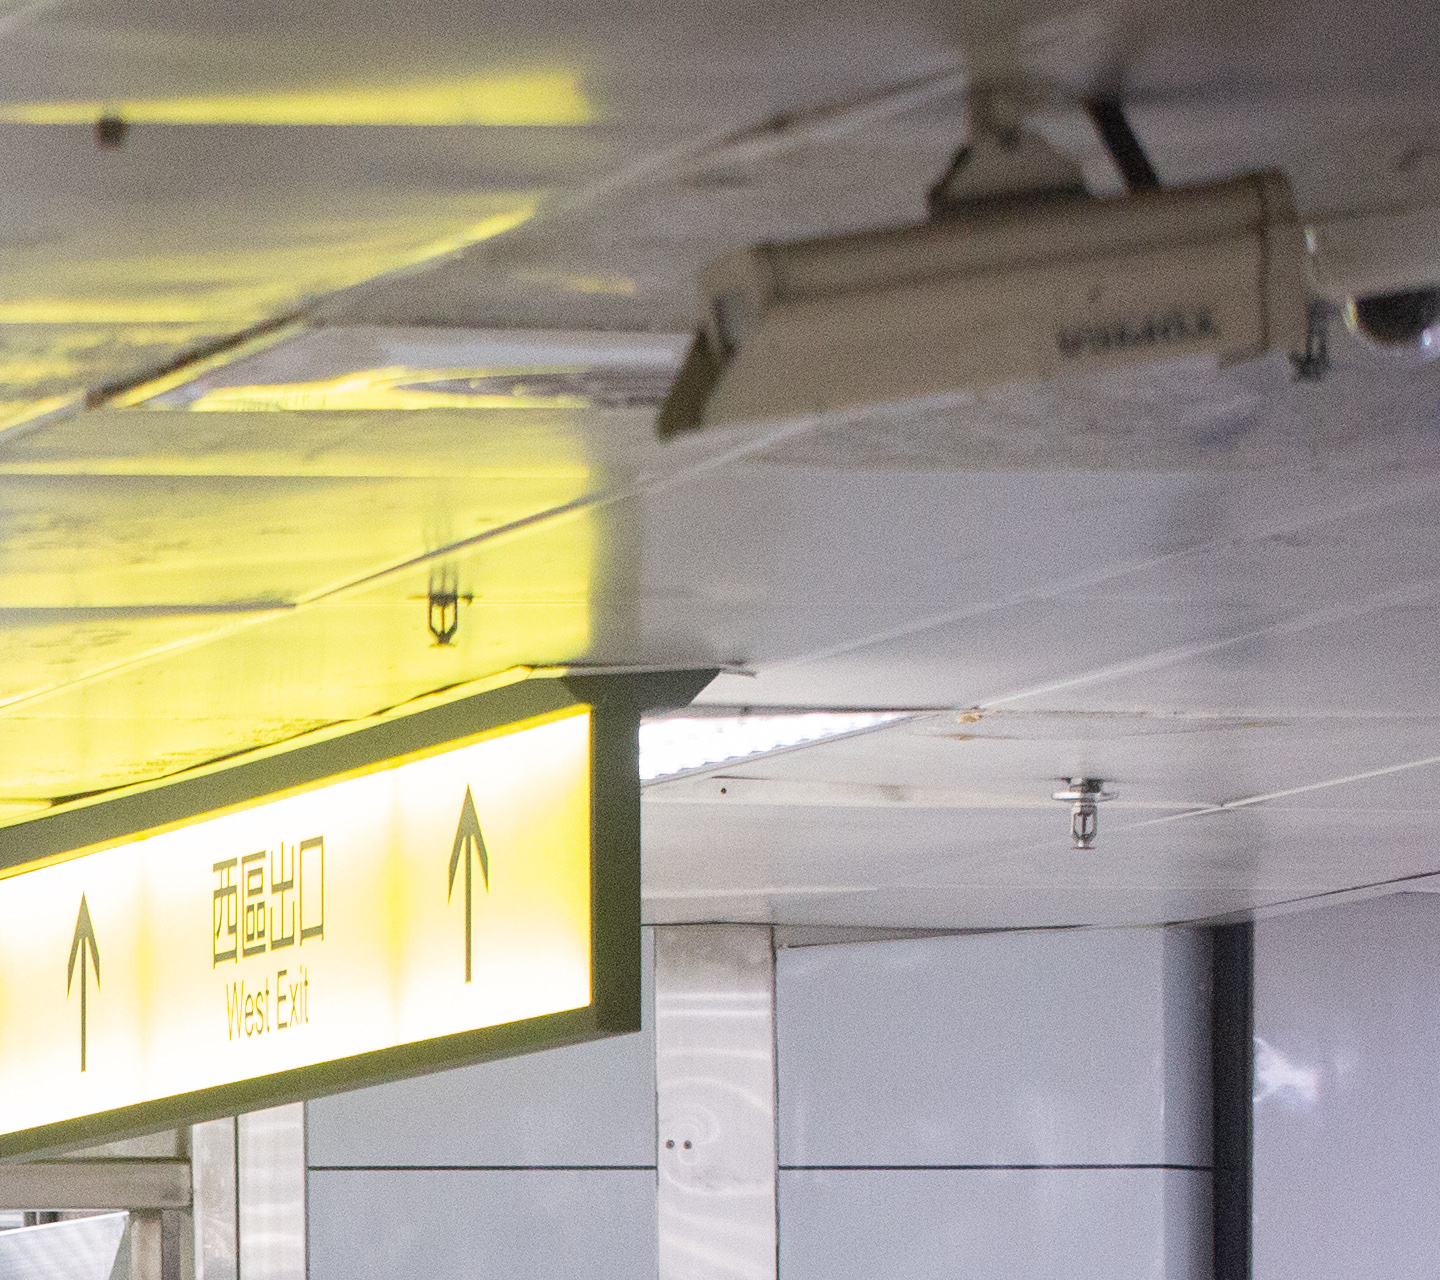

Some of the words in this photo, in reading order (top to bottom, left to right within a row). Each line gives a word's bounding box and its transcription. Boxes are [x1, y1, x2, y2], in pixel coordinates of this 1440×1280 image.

[212, 835, 325, 968] 西區出口
[225, 980, 270, 1041] West
[277, 967, 309, 1030] Exit
